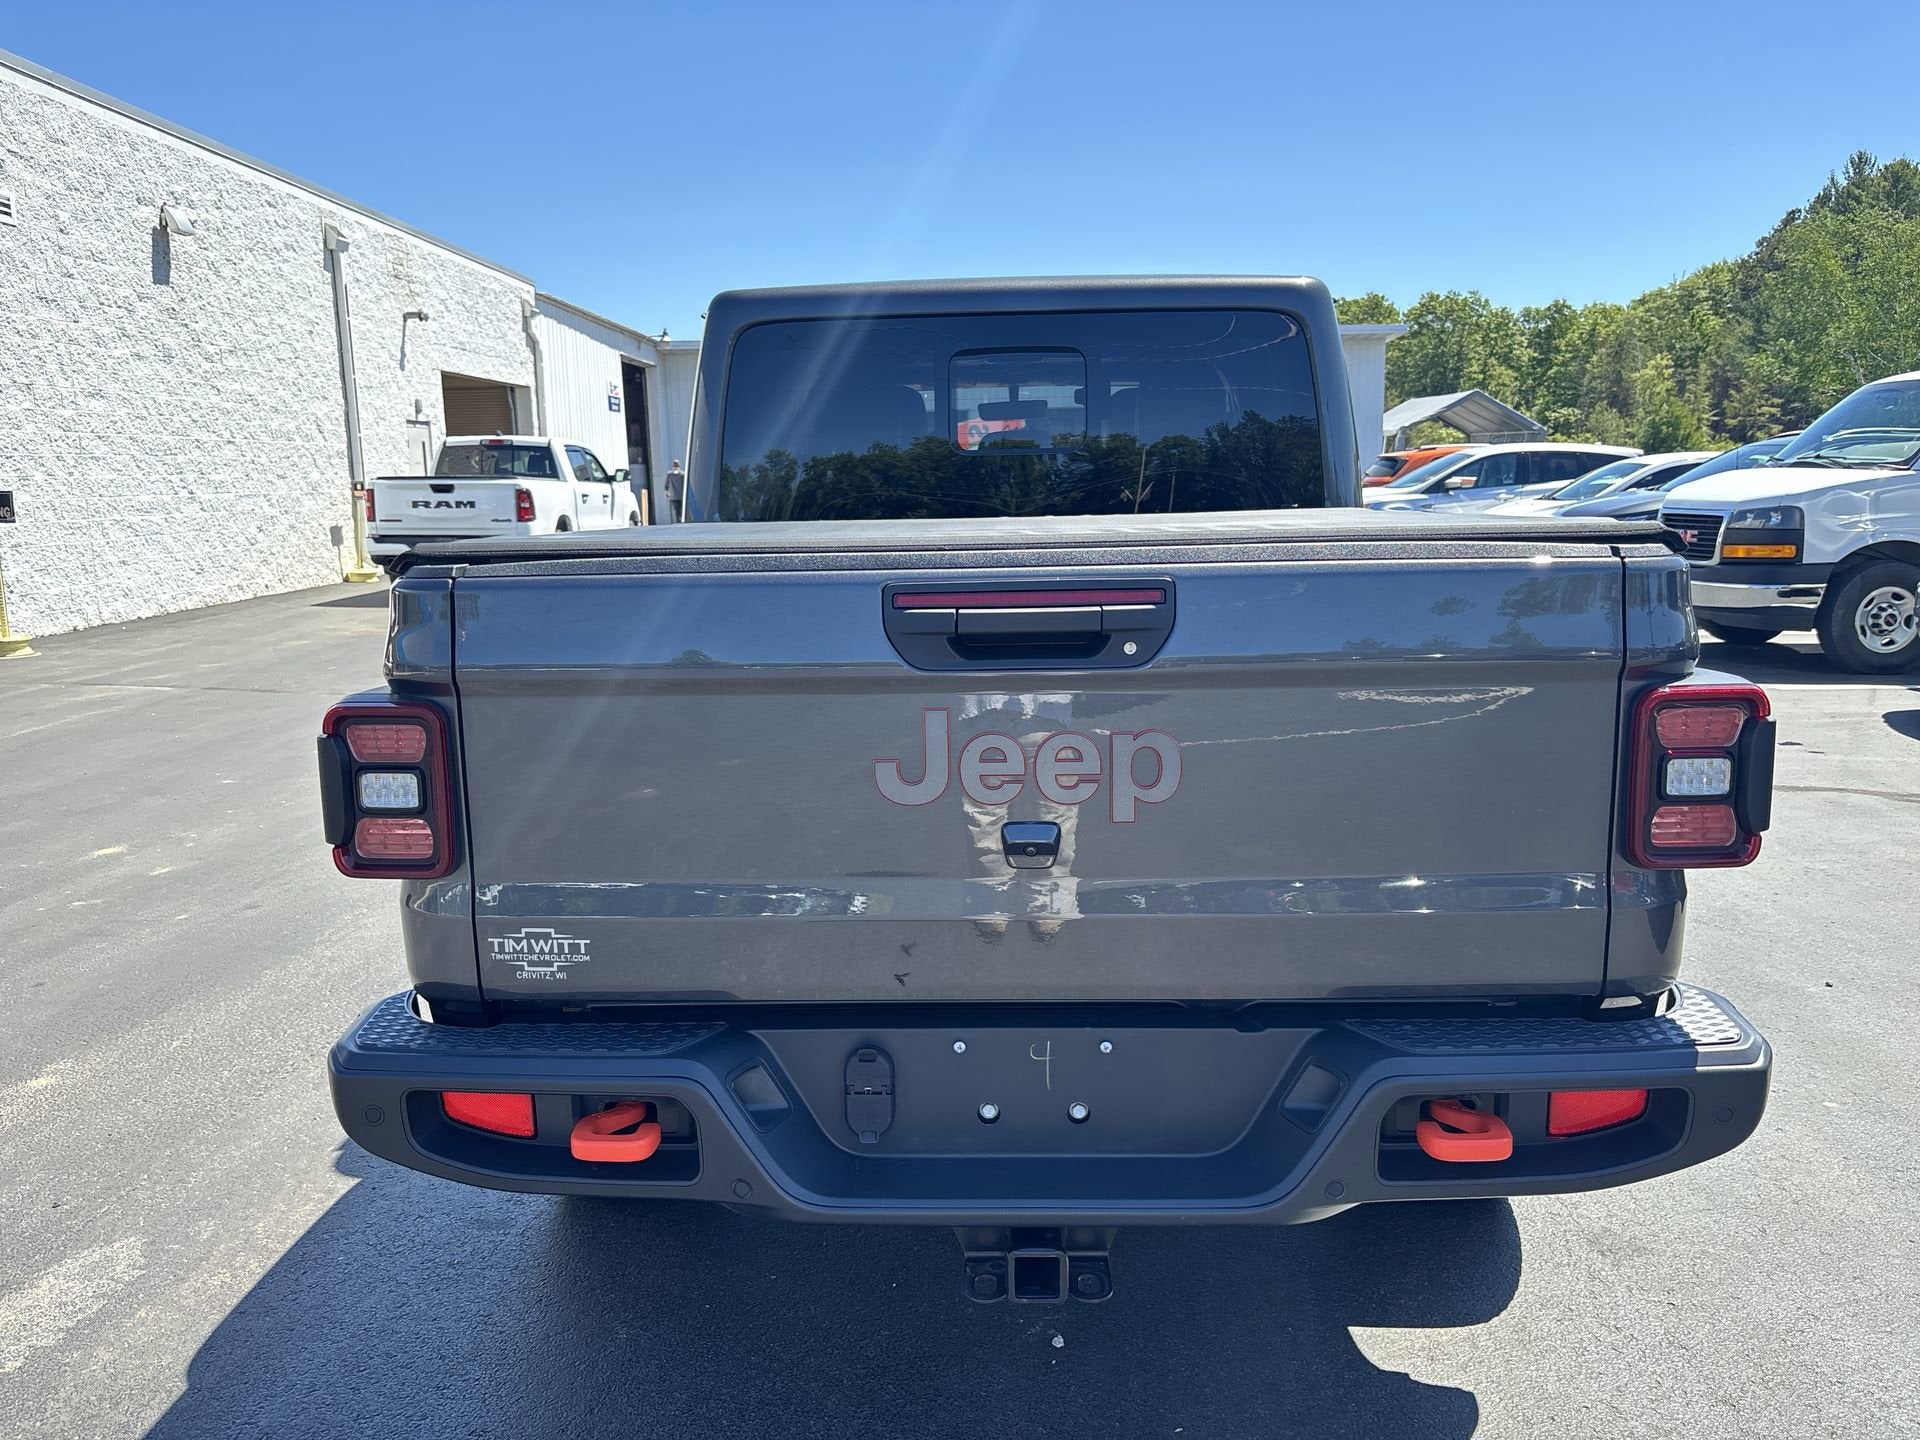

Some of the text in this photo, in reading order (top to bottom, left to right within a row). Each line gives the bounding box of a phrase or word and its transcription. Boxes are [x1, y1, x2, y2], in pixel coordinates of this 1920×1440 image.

[412, 501, 476, 509] RAM
[872, 707, 1183, 823] Jeep
[488, 938, 591, 954] TIM WITT
[490, 953, 590, 962] TIMWITTCHEVROLET.COM
[516, 971, 567, 980] CRIVITZ, WI
[1029, 1040, 1055, 1091] 4
